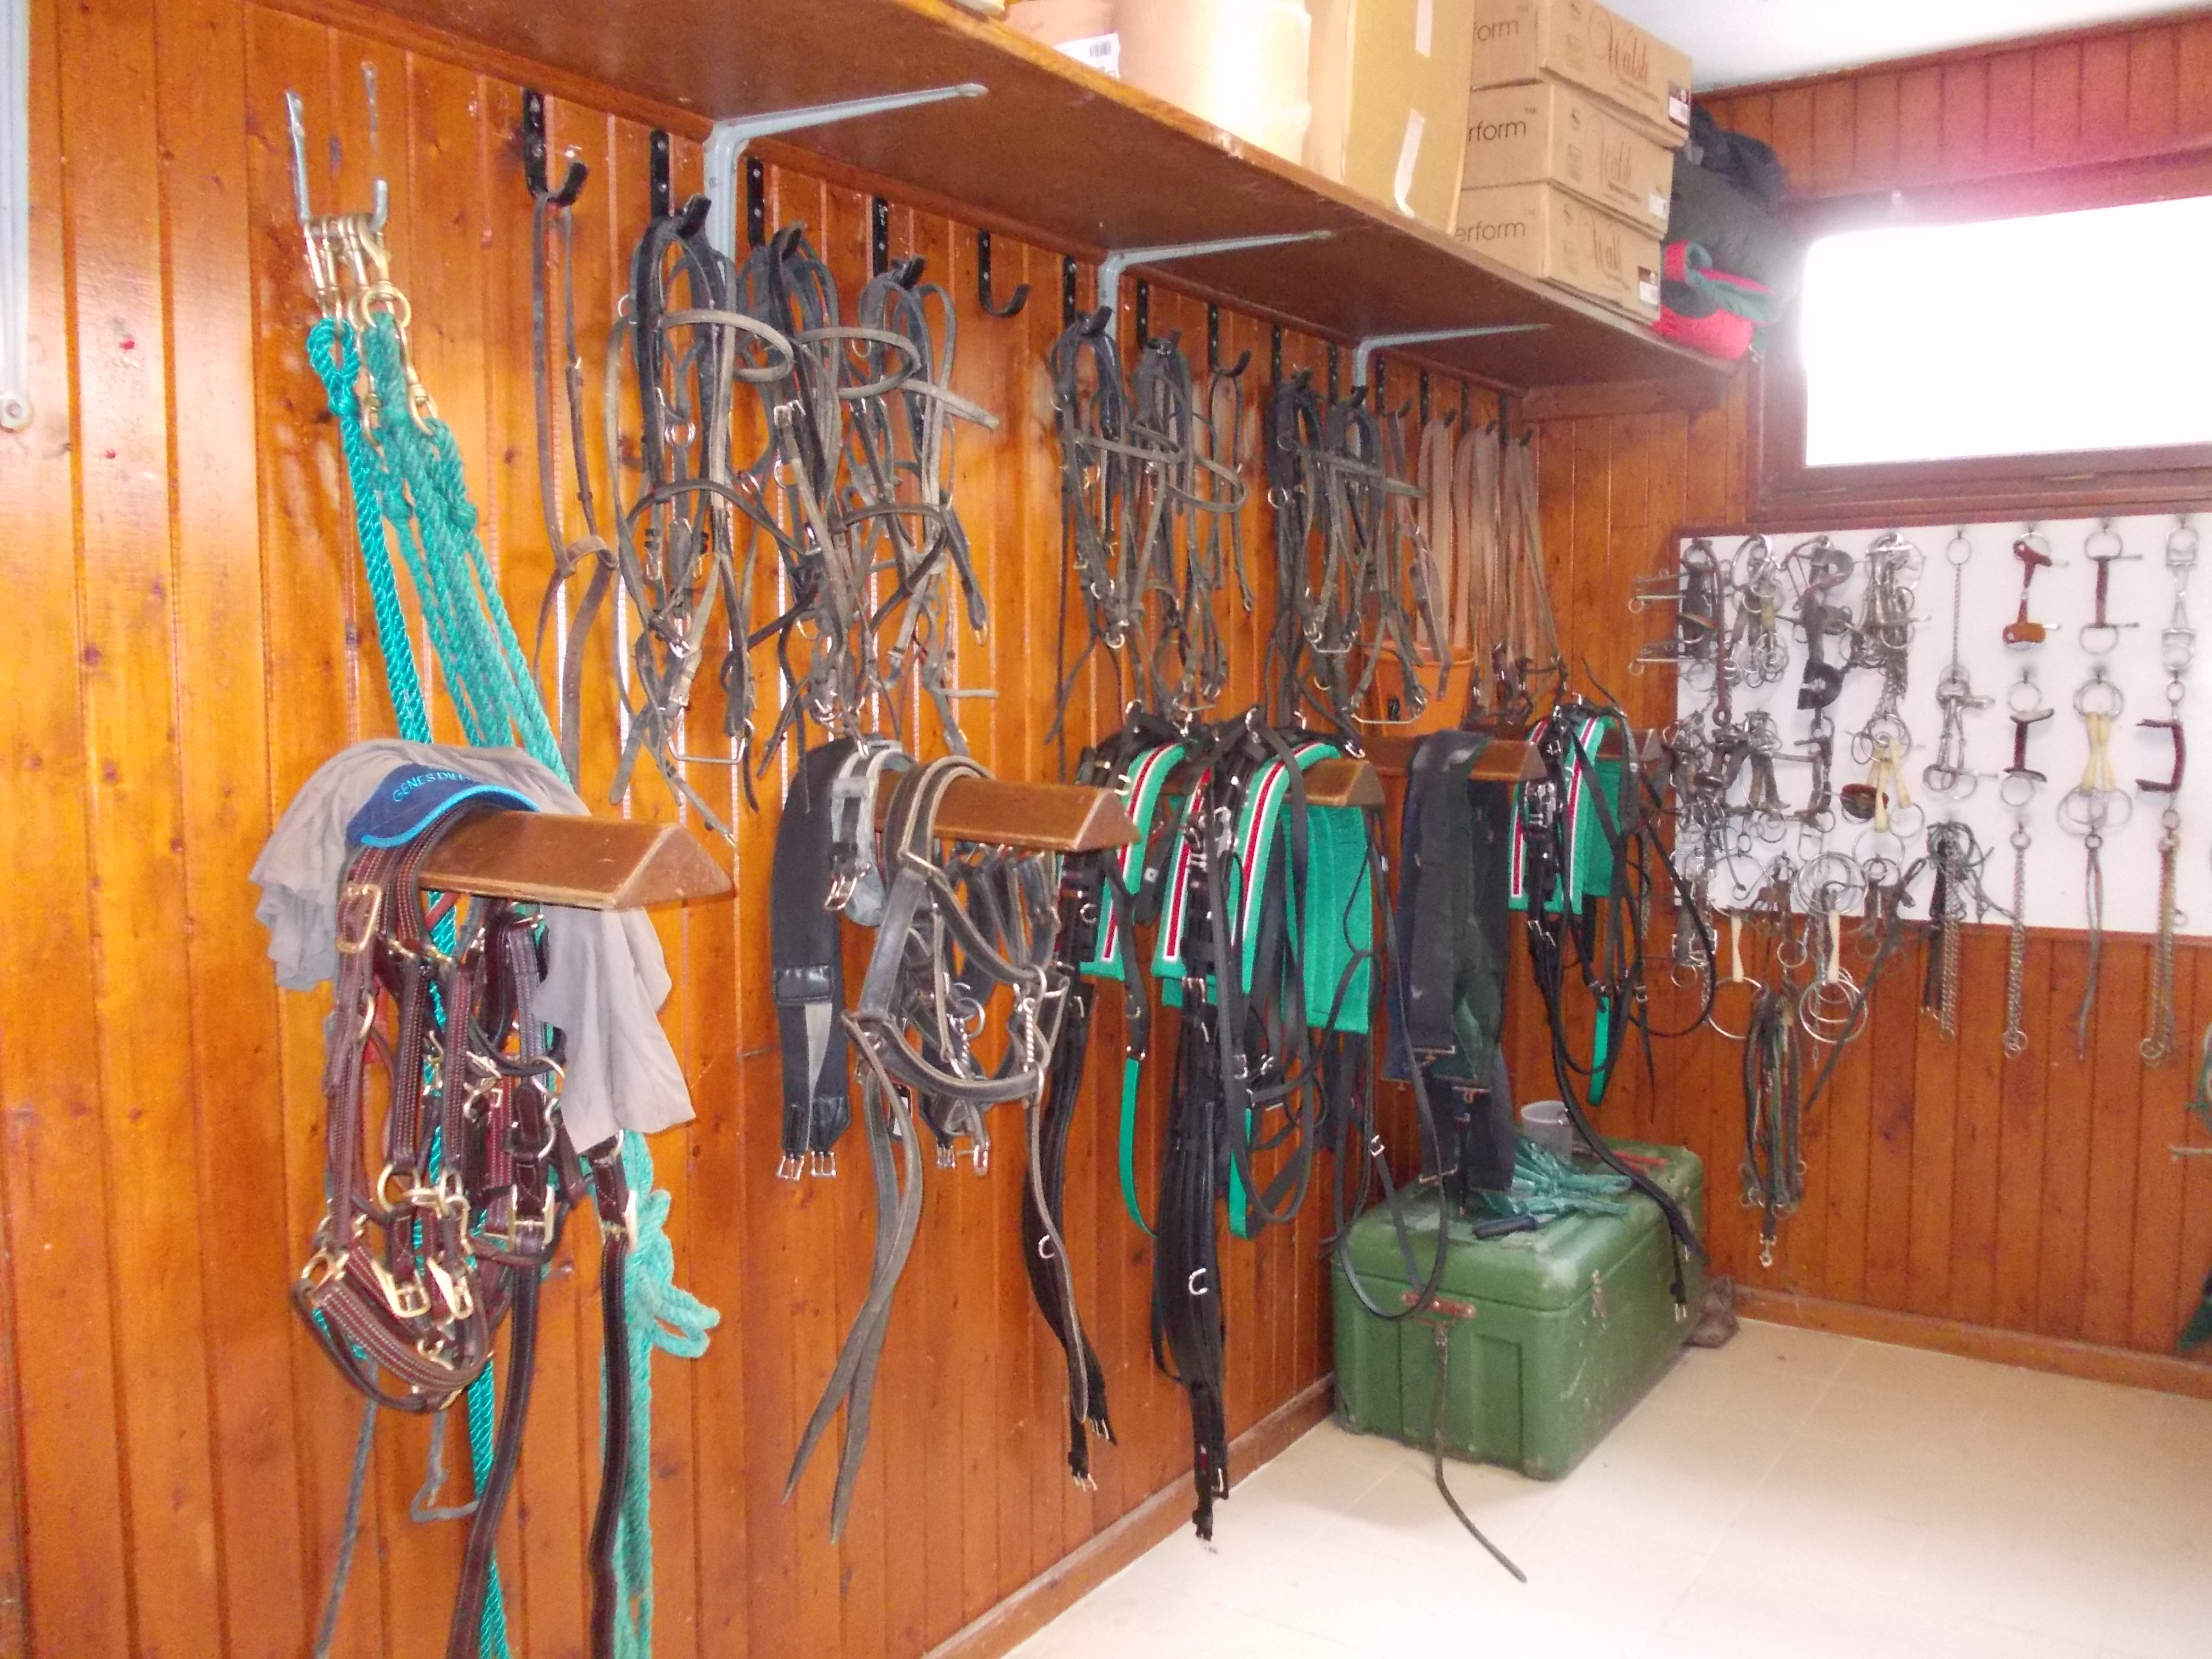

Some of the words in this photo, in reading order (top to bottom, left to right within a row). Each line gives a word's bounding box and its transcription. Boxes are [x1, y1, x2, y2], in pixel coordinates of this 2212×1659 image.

[1477, 19, 1519, 42] orm
[1467, 120, 1527, 142] rform
[1455, 220, 1525, 243] erform
